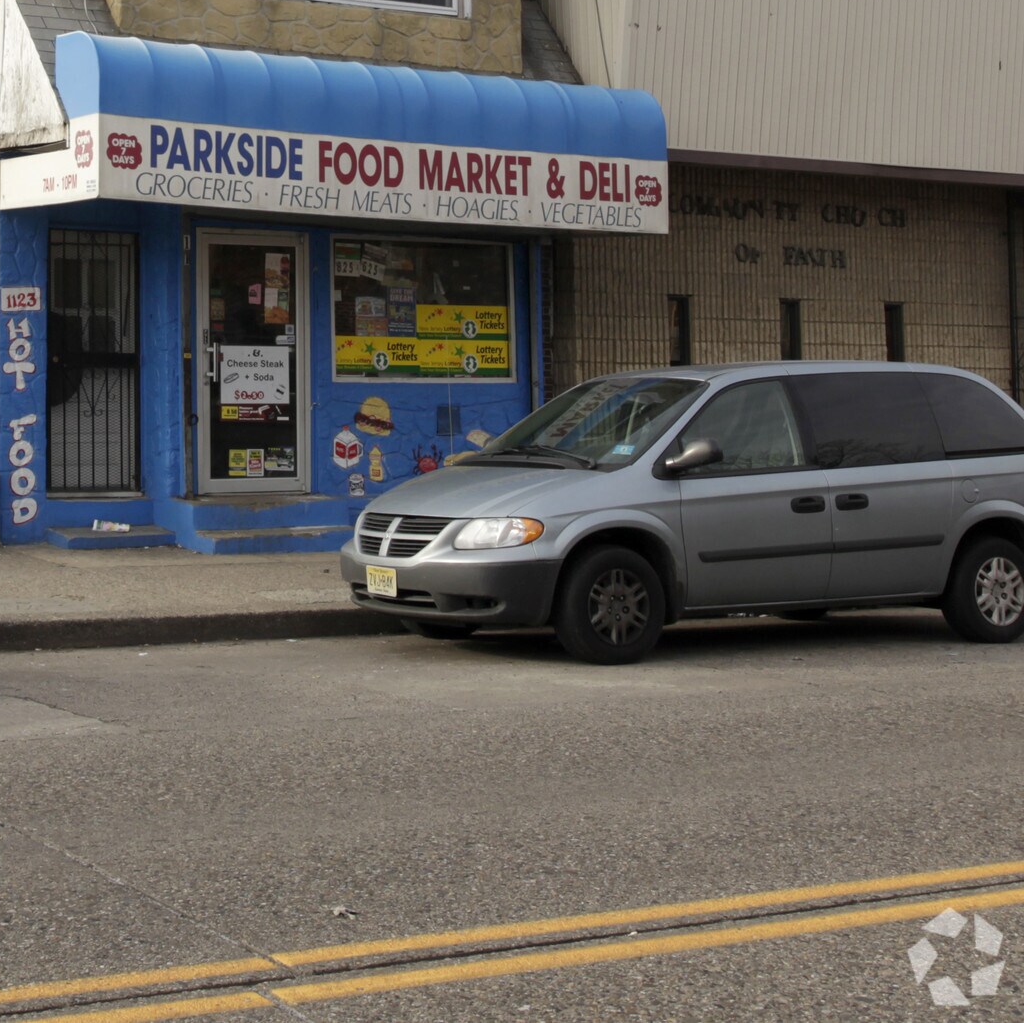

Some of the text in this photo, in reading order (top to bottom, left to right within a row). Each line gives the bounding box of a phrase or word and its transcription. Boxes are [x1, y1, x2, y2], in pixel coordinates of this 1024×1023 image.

[112, 138, 135, 148] OPEN
[120, 147, 127, 155] 7
[112, 155, 135, 164] DAYS
[150, 125, 631, 202] PARKSIDE FOOD MARKET & DELI
[43, 177, 55, 193] 7AM
[62, 174, 77, 190] 10PM
[638, 180, 657, 189] OPEN
[135, 172, 642, 228] GROCERIES FRESH MEATS HOAGIES VEGETABLES
[639, 194, 657, 203] DAYS
[7, 292, 38, 309] 1123
[476, 311, 503, 323] Lottery
[480, 320, 505, 330] Tickets
[387, 342, 415, 355] Lottery
[476, 346, 503, 358] Lottery
[3, 318, 37, 391] HOT
[391, 352, 418, 361] Tickets
[480, 355, 506, 364] Tickets
[226, 360, 284, 368] Cheese Steak
[253, 373, 274, 381] Soda
[9, 414, 39, 525] FOOD
